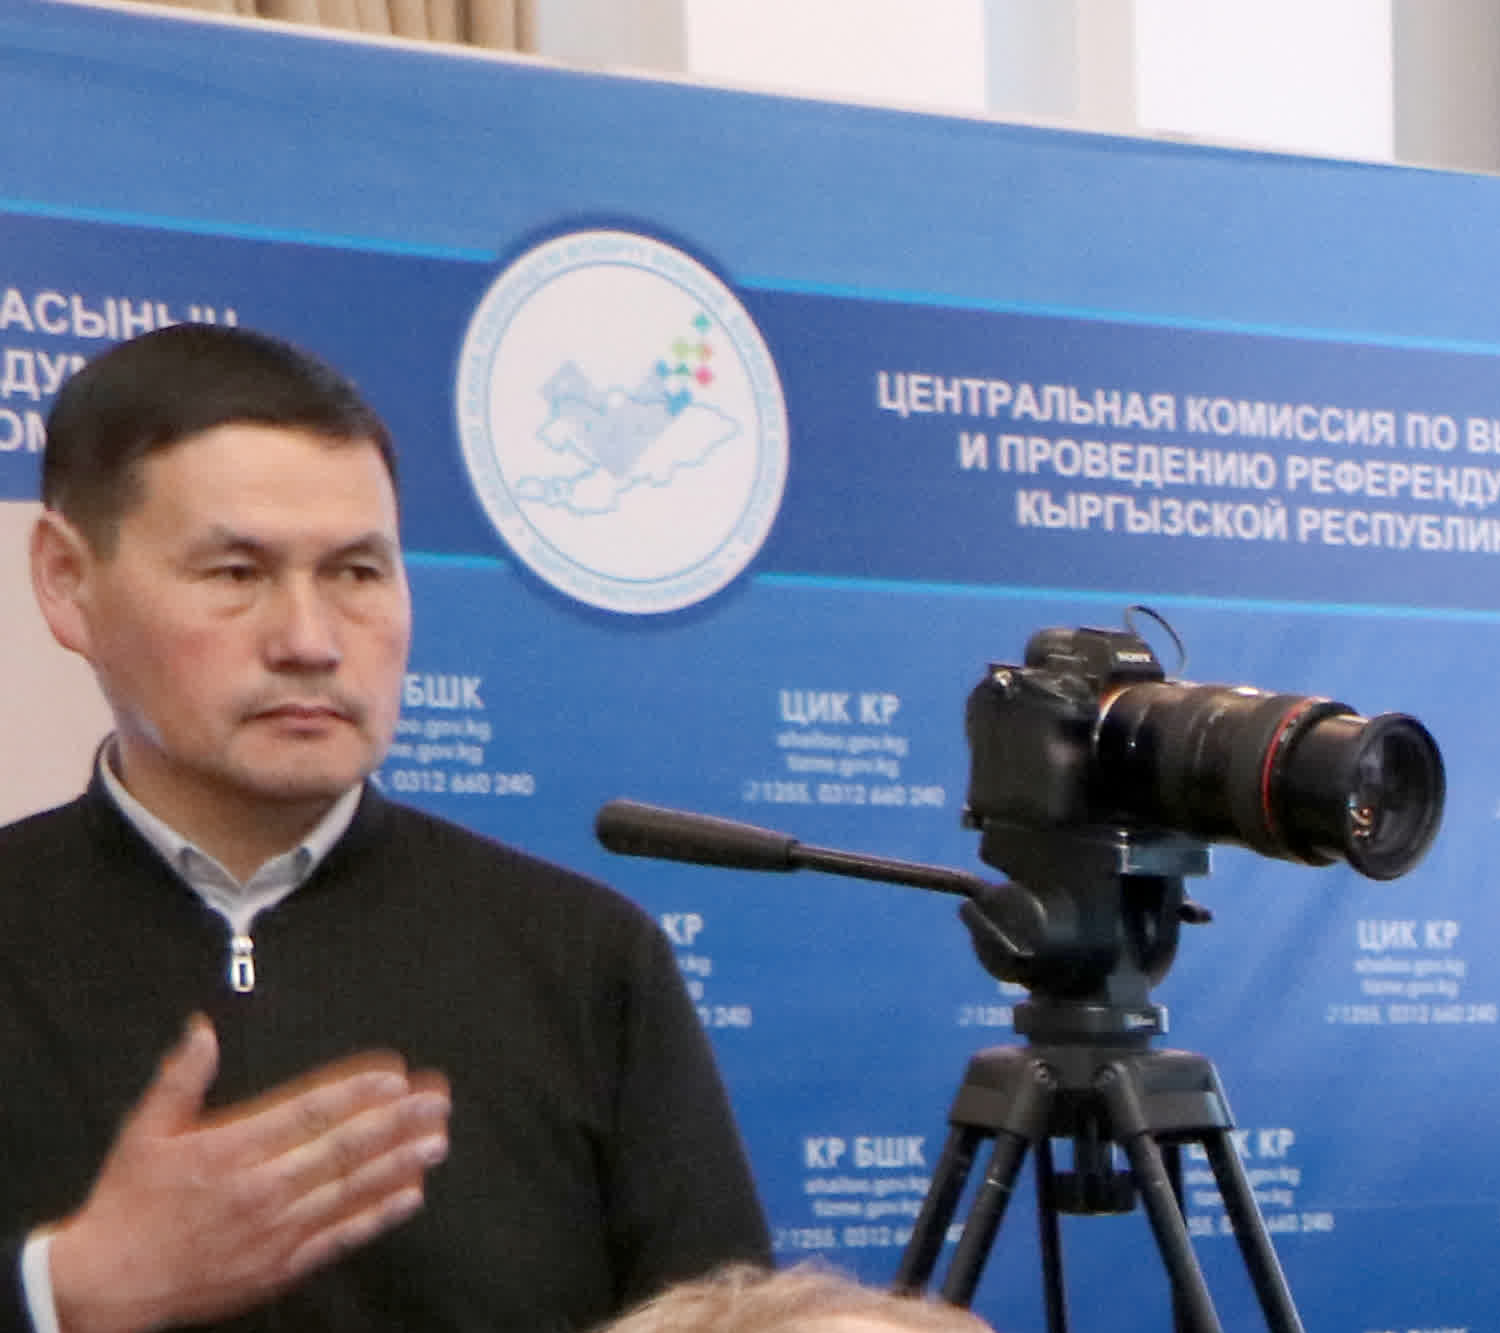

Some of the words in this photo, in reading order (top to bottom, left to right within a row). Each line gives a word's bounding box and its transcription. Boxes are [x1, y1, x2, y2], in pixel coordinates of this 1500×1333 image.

[0, 349, 87, 401] ДУ
[877, 370, 1178, 431] ЦЕНТРАЛЬНАЯ
[1185, 396, 1396, 448] КОМИССИЯ
[1405, 411, 1459, 452] ПО
[957, 431, 988, 470] И
[998, 433, 1277, 490] ПРОВЕДЕНИЮ
[1015, 489, 1288, 541] КЫРГЫЗСКОЙ
[404, 674, 485, 709] БШК
[779, 690, 851, 725] ЦИК
[859, 693, 901, 725] КР
[661, 913, 704, 944] КР
[1357, 920, 1418, 953] ЦИК
[1425, 920, 1461, 950] КР
[805, 1137, 847, 1168] КР
[855, 1137, 926, 1168] БШК
[1258, 1128, 1296, 1157] КР
